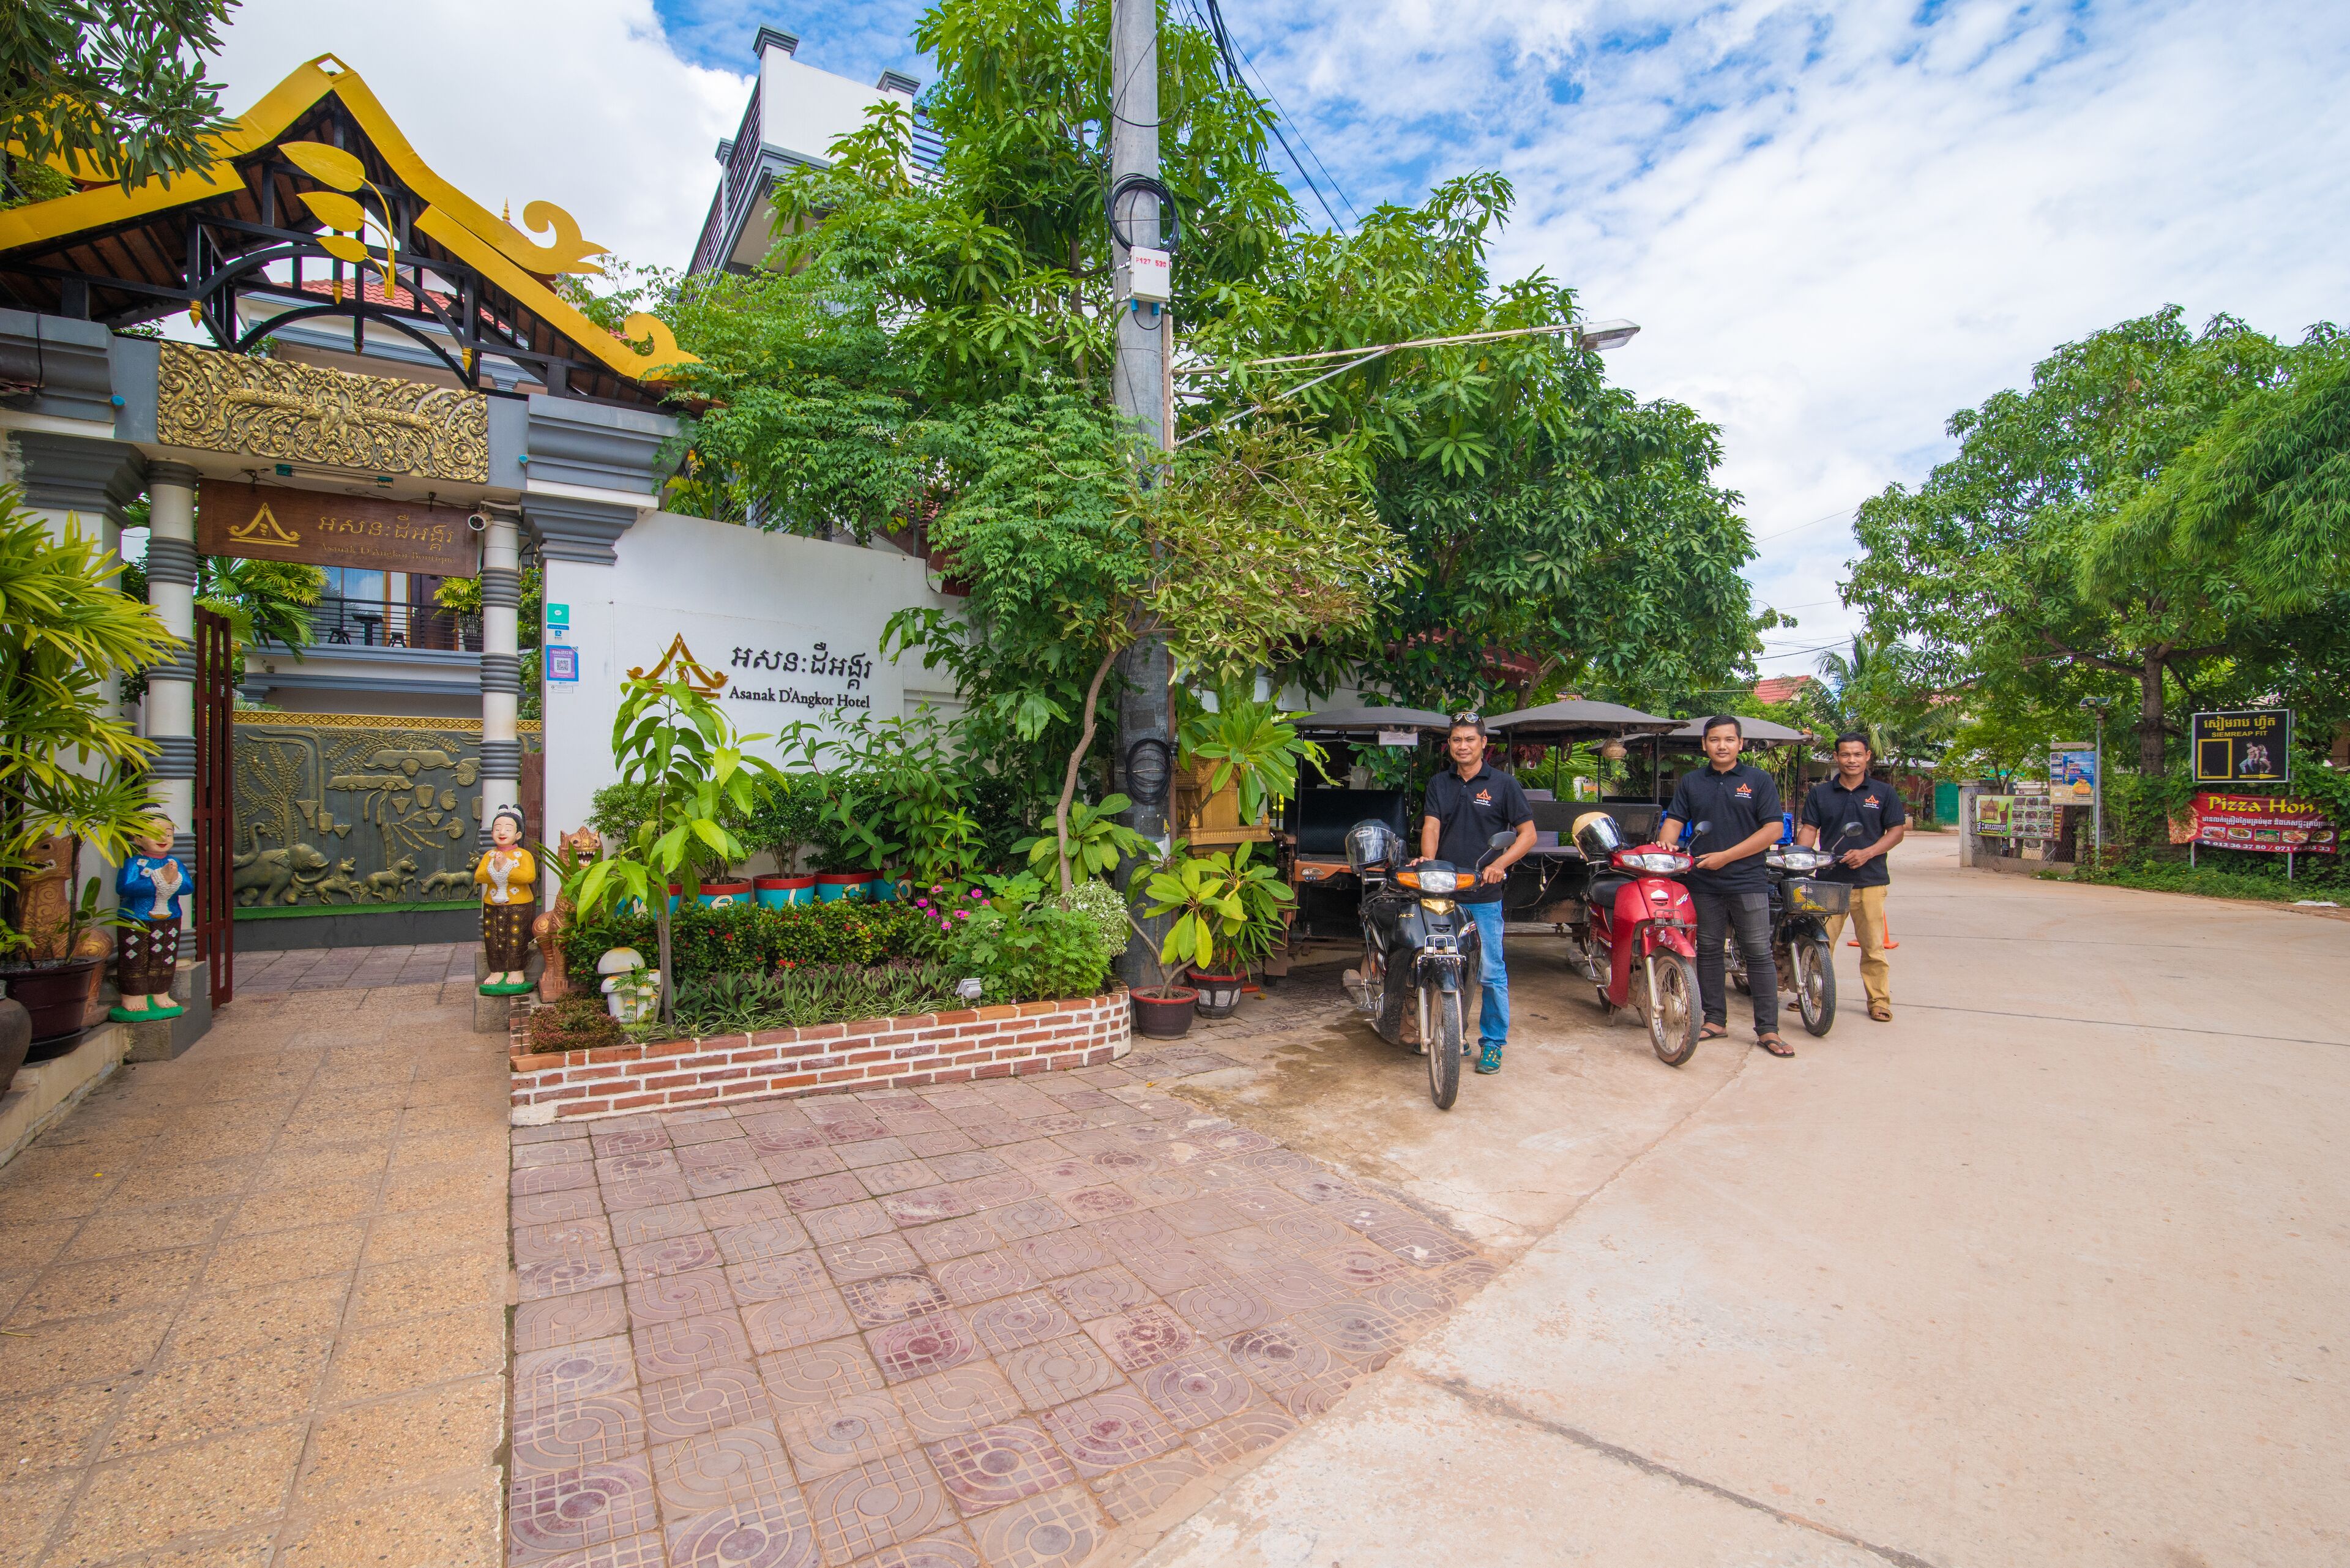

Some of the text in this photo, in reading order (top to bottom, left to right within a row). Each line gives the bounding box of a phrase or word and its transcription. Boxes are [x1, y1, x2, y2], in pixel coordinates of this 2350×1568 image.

[321, 543, 356, 554] Asanak
[411, 551, 455, 564] Boutique
[729, 685, 870, 708] Asanak D'Angkor Hotel
[2207, 796, 2324, 814] Pizza Hom
